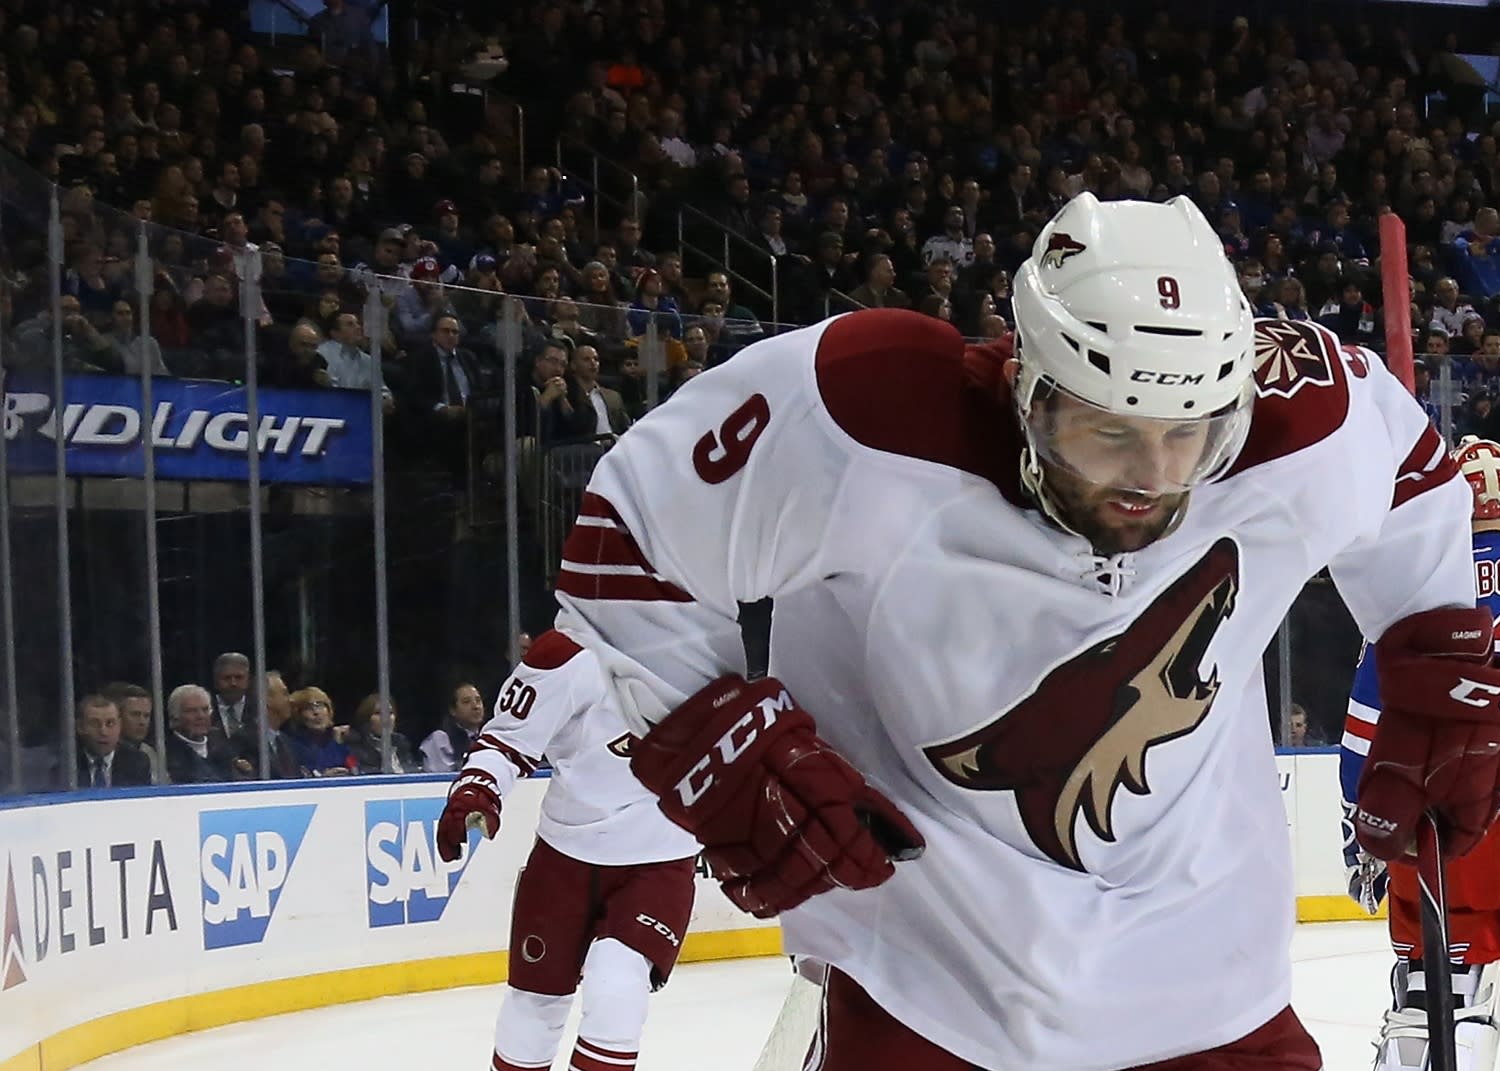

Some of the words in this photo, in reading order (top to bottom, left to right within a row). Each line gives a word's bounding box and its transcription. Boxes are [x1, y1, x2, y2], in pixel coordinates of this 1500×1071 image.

[1157, 276, 1181, 309] 9
[1130, 369, 1204, 386] CCM
[150, 401, 346, 456] LIGHT
[692, 392, 771, 485] 9
[499, 677, 538, 721] 50
[674, 689, 794, 808] CCM
[32, 839, 179, 962] DELTA
[201, 831, 288, 925] SAP
[636, 913, 680, 948] CCM
